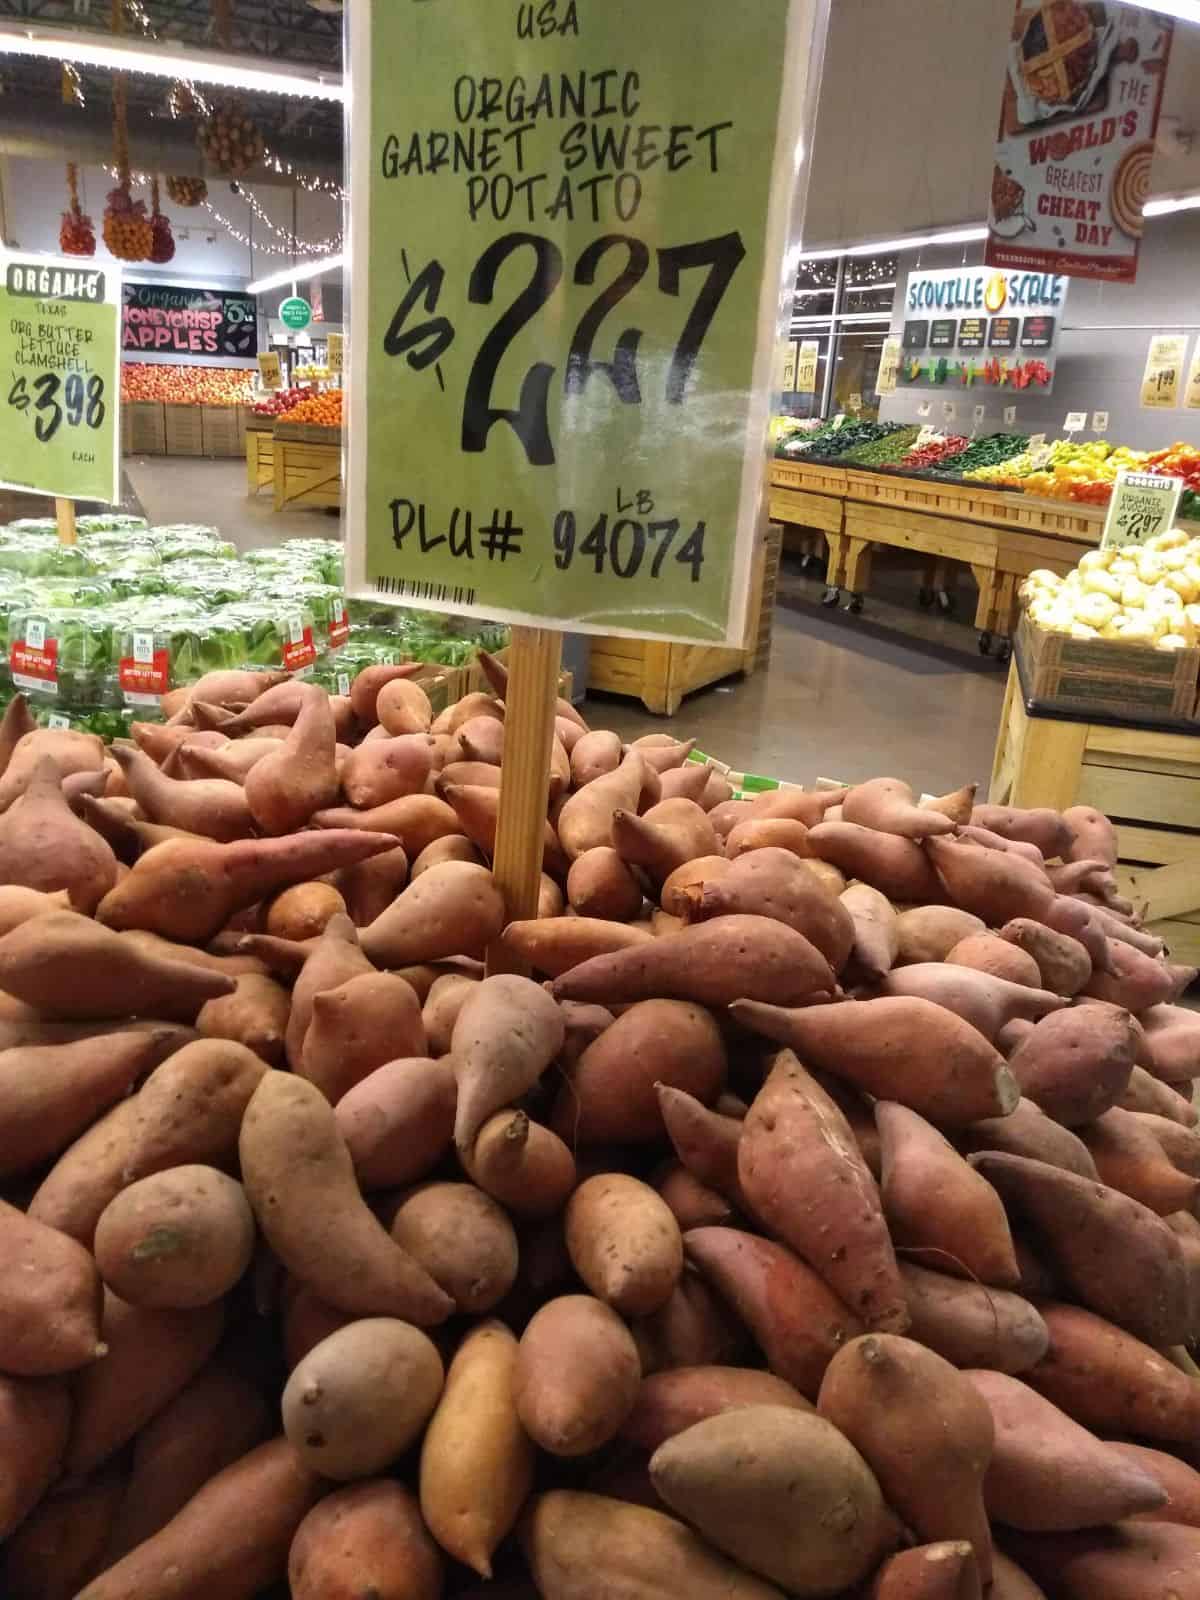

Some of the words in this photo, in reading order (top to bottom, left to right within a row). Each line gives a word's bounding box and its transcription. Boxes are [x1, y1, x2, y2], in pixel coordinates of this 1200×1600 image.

[516, 0, 580, 38] USA
[453, 70, 641, 123] ORGANIC
[1120, 80, 1150, 106] THE
[382, 124, 537, 178] GARNET
[559, 121, 733, 173] SWEET
[1028, 110, 1137, 165] WORLD'S
[1046, 165, 1104, 193] GREATEST
[466, 174, 643, 222] POTATO
[1037, 194, 1102, 221] CHEAT
[1074, 222, 1114, 246] DAY
[13, 267, 98, 298] ORGANIC
[908, 277, 984, 311] SCOVILLE
[1008, 274, 1062, 306] SCALE
[10, 319, 32, 337] ORG
[38, 323, 94, 343] BUTTER
[121, 326, 219, 352] APPLES
[20, 336, 80, 357] LETTUCE
[15, 350, 94, 373] CLAMSHELL
[616, 487, 654, 514] LB
[552, 509, 706, 583] 94074
